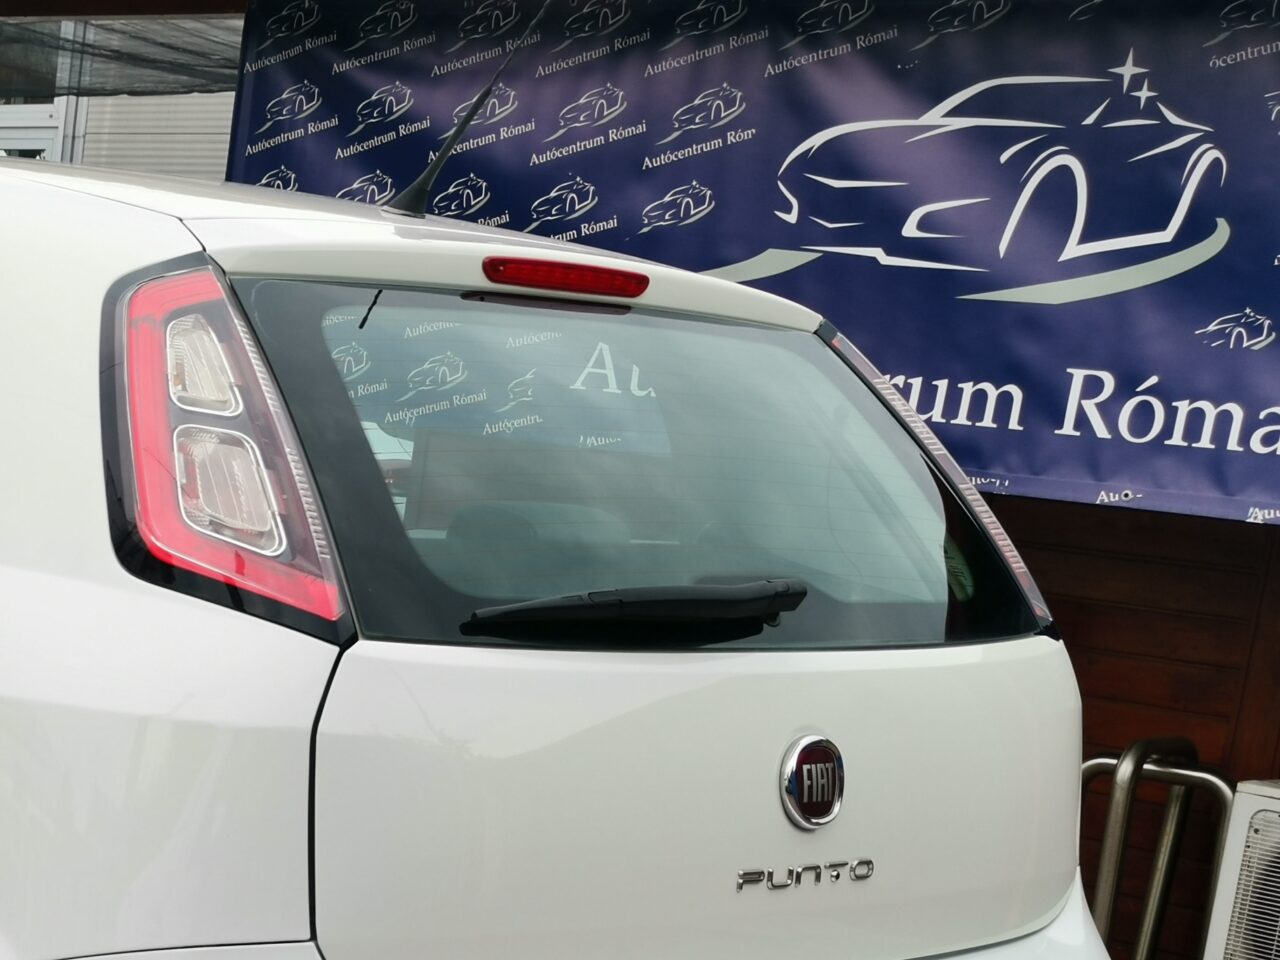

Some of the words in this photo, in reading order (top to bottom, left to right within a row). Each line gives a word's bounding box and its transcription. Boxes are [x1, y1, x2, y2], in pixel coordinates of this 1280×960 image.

[243, 44, 304, 74] Autócentrum
[305, 31, 338, 51] Római
[331, 46, 402, 75] Autócentrum
[403, 32, 437, 53] Római
[431, 46, 503, 77] Autócentrum
[535, 46, 611, 78] Autócentrum
[614, 28, 652, 52] Római
[644, 43, 726, 78] Autócentrum
[728, 25, 770, 50] Római
[764, 43, 853, 78] Autócentrum
[856, 24, 899, 50] Római
[245, 127, 305, 157] Autócentrum
[307, 114, 340, 135] Római
[335, 130, 398, 160] Autócentrum
[399, 116, 431, 137] Római
[499, 118, 536, 140] Római
[529, 135, 606, 167] Autócentrum
[608, 120, 648, 143] Római
[642, 137, 723, 170] Autócentrum
[580, 215, 618, 236] Római
[357, 378, 388, 397] Római
[453, 388, 488, 407] Római
[802, 762, 835, 803] FIAT
[736, 858, 874, 893] PUNTO
